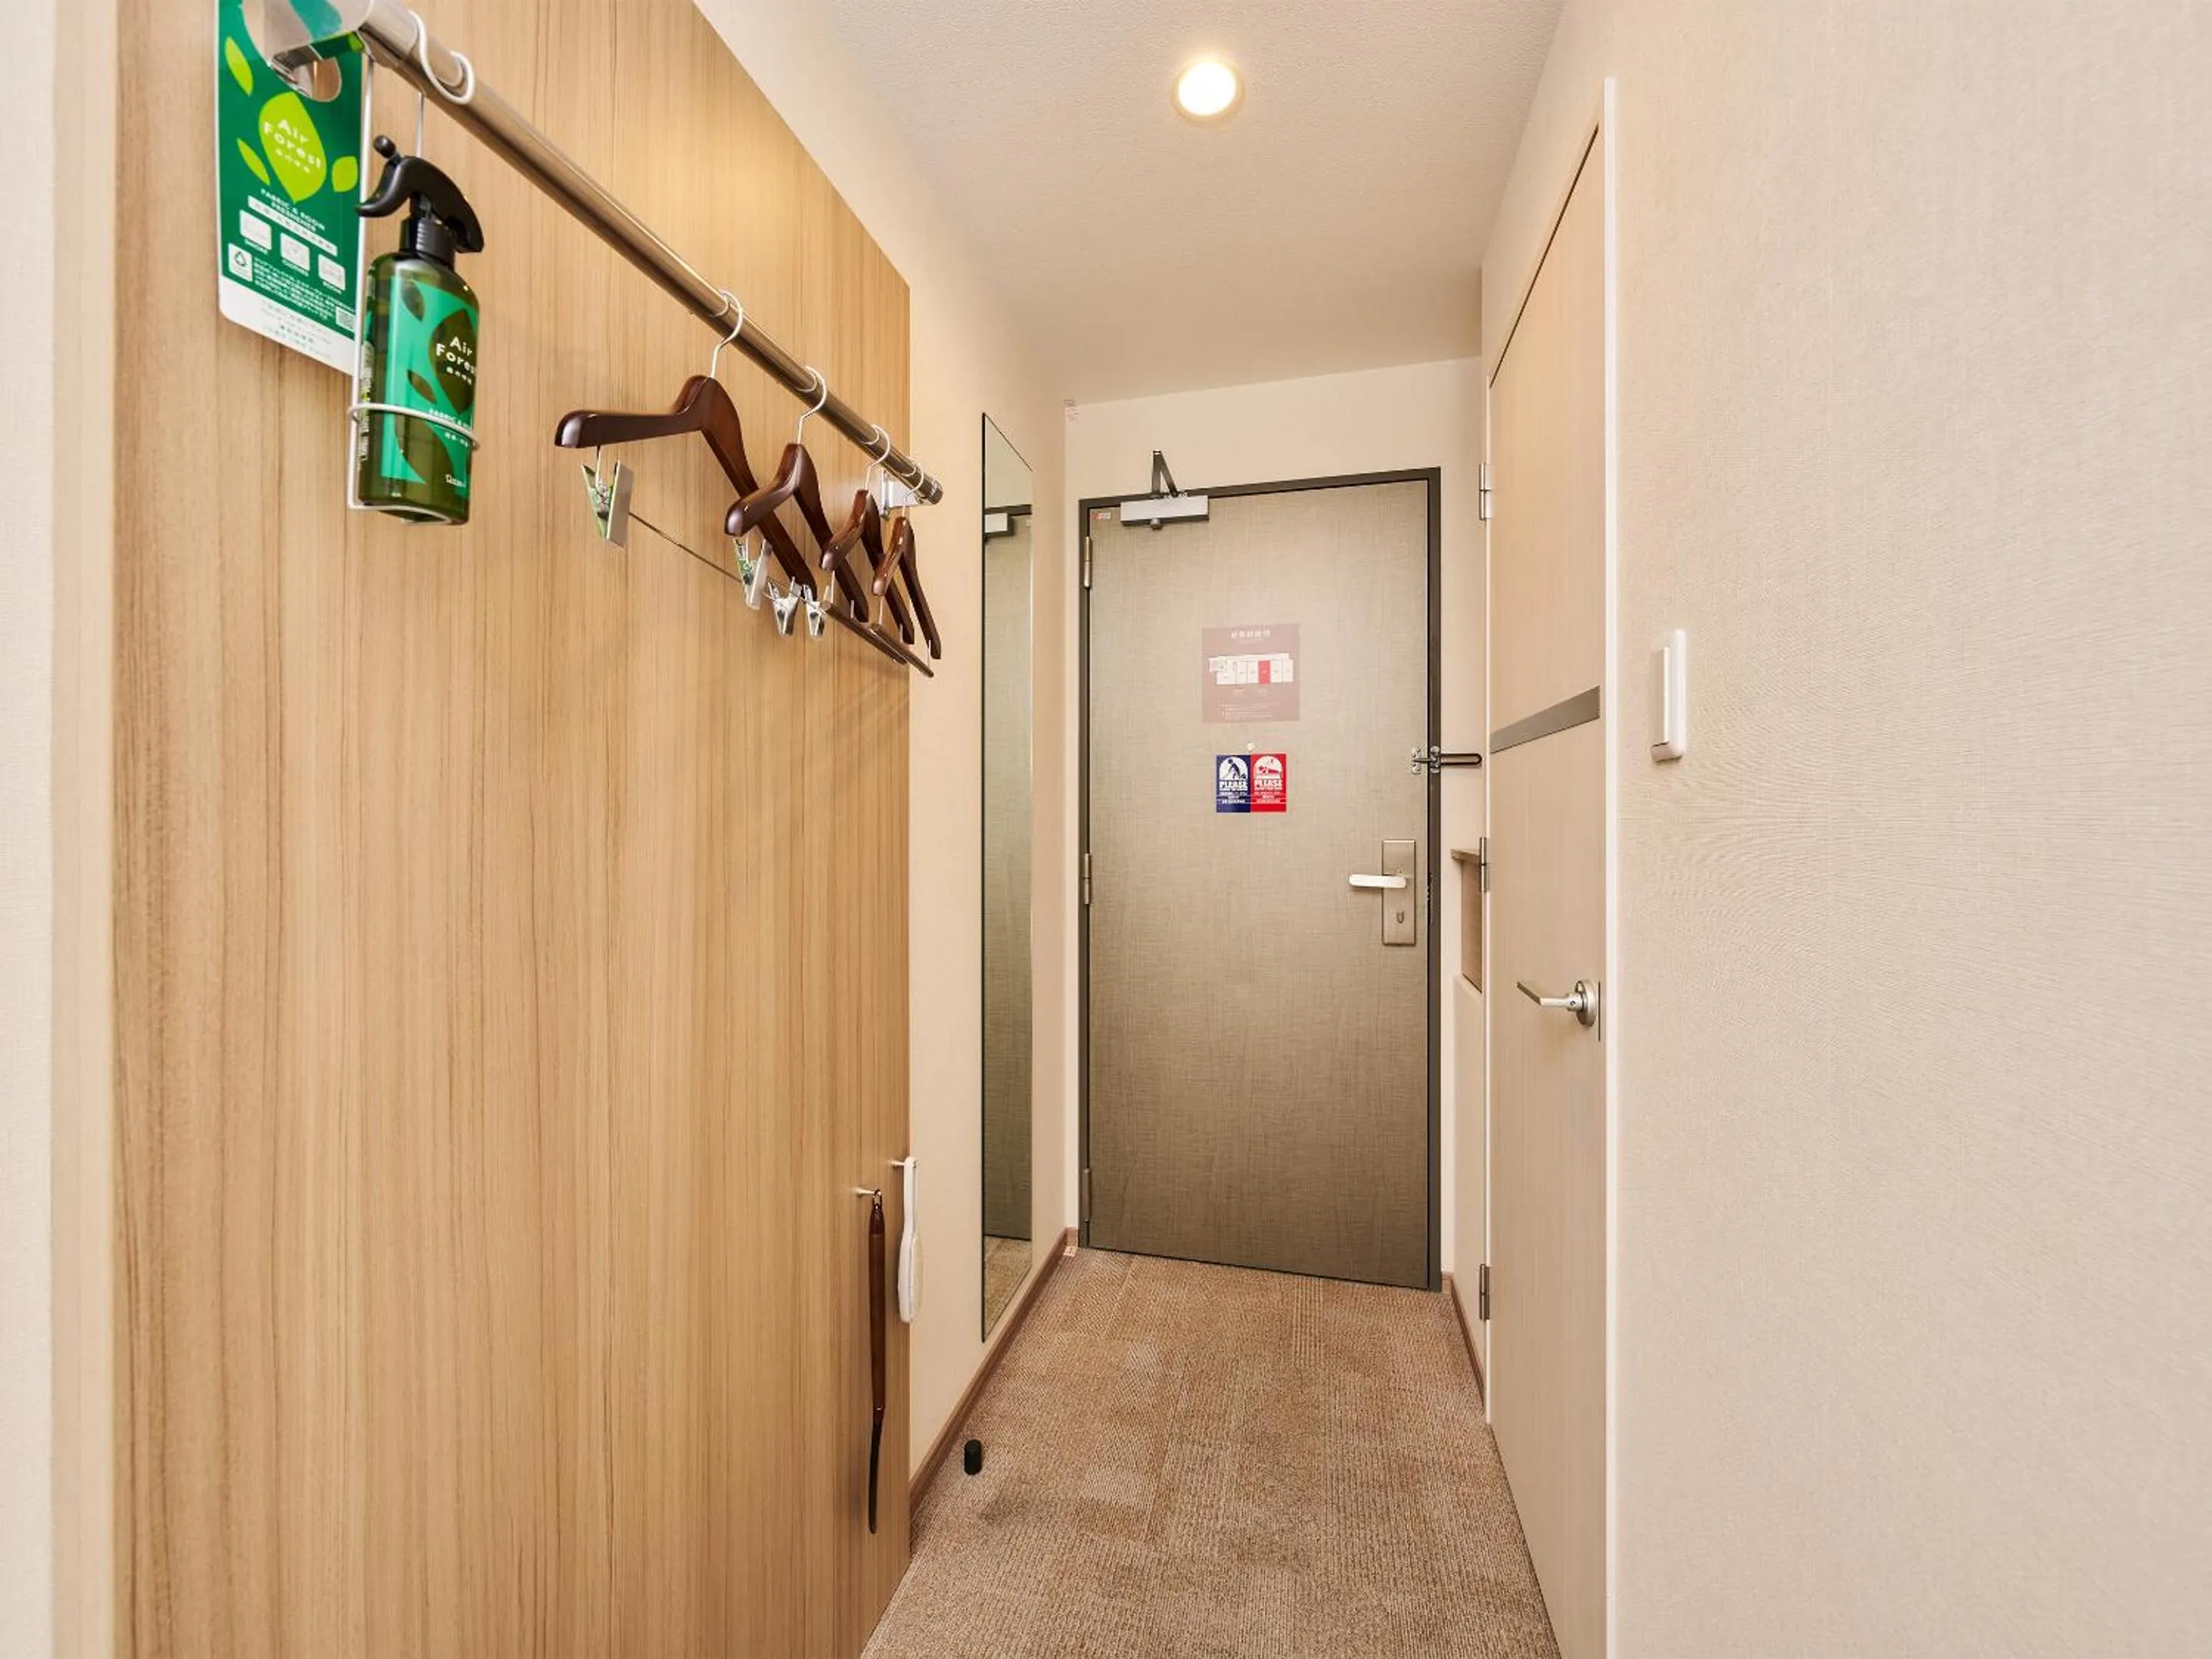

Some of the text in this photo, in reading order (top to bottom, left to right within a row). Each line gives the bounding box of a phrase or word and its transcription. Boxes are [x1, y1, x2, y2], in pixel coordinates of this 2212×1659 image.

[278, 119, 308, 144] Air
[263, 121, 321, 169] Forest
[449, 336, 472, 356] Air
[436, 343, 475, 375] Fores
[1219, 780, 1248, 789] PLEASE
[1254, 780, 1283, 788] PLEASE
